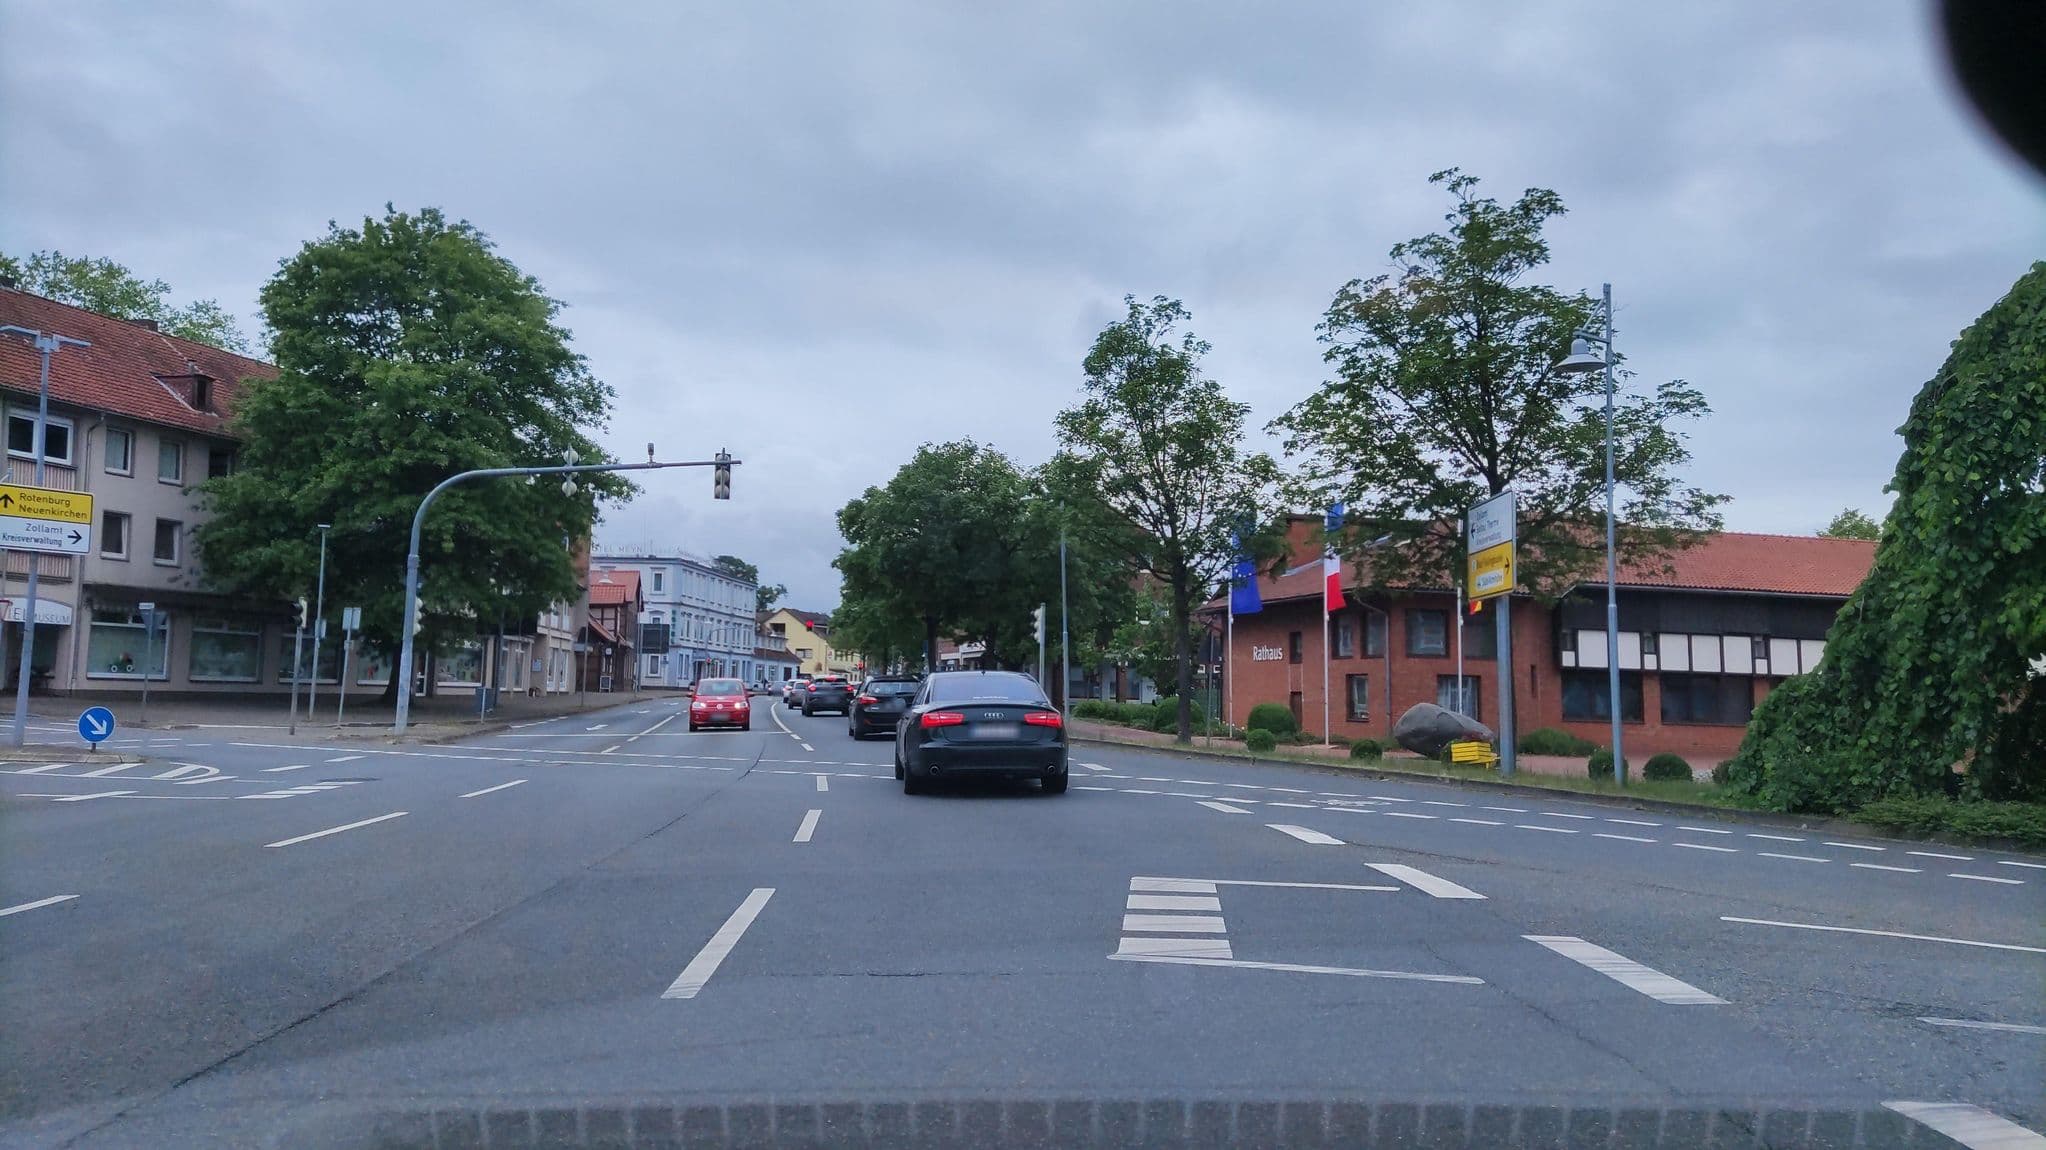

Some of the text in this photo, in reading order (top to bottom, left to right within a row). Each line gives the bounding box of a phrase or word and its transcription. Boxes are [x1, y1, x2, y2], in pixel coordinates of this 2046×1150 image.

[19, 492, 71, 508] Rotenburg
[19, 504, 88, 519] Neuenkirchen
[25, 523, 63, 535] Zollamt
[2, 532, 63, 547] Kreisverwaltung
[1253, 644, 1283, 661] Rathaus
